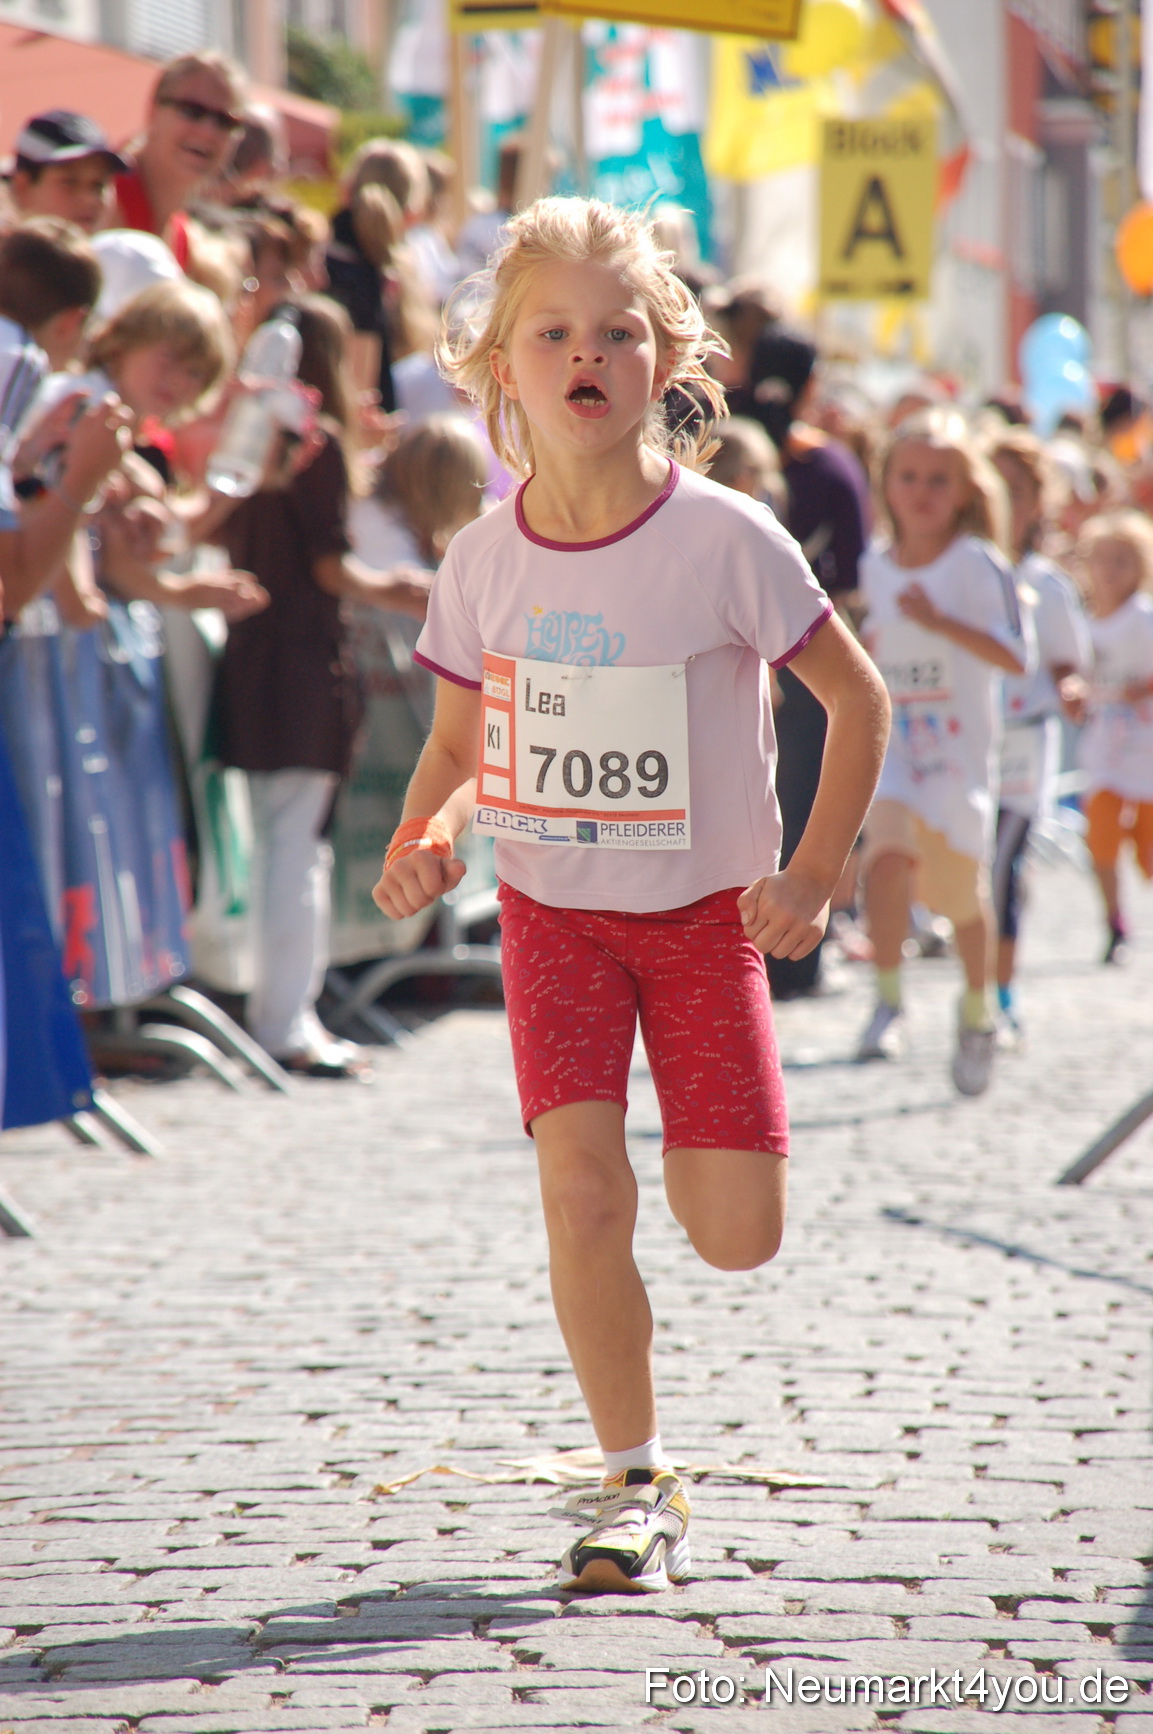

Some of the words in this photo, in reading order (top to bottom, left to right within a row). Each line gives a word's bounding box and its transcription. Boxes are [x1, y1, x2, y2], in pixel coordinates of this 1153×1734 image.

[840, 173, 907, 264] A
[525, 677, 566, 717] Lea
[529, 744, 669, 799] 7089
[477, 808, 548, 834] BOCK
[600, 822, 686, 838] PFLEIDERER
[601, 837, 687, 848] AKTIENGESELLSCHAFT
